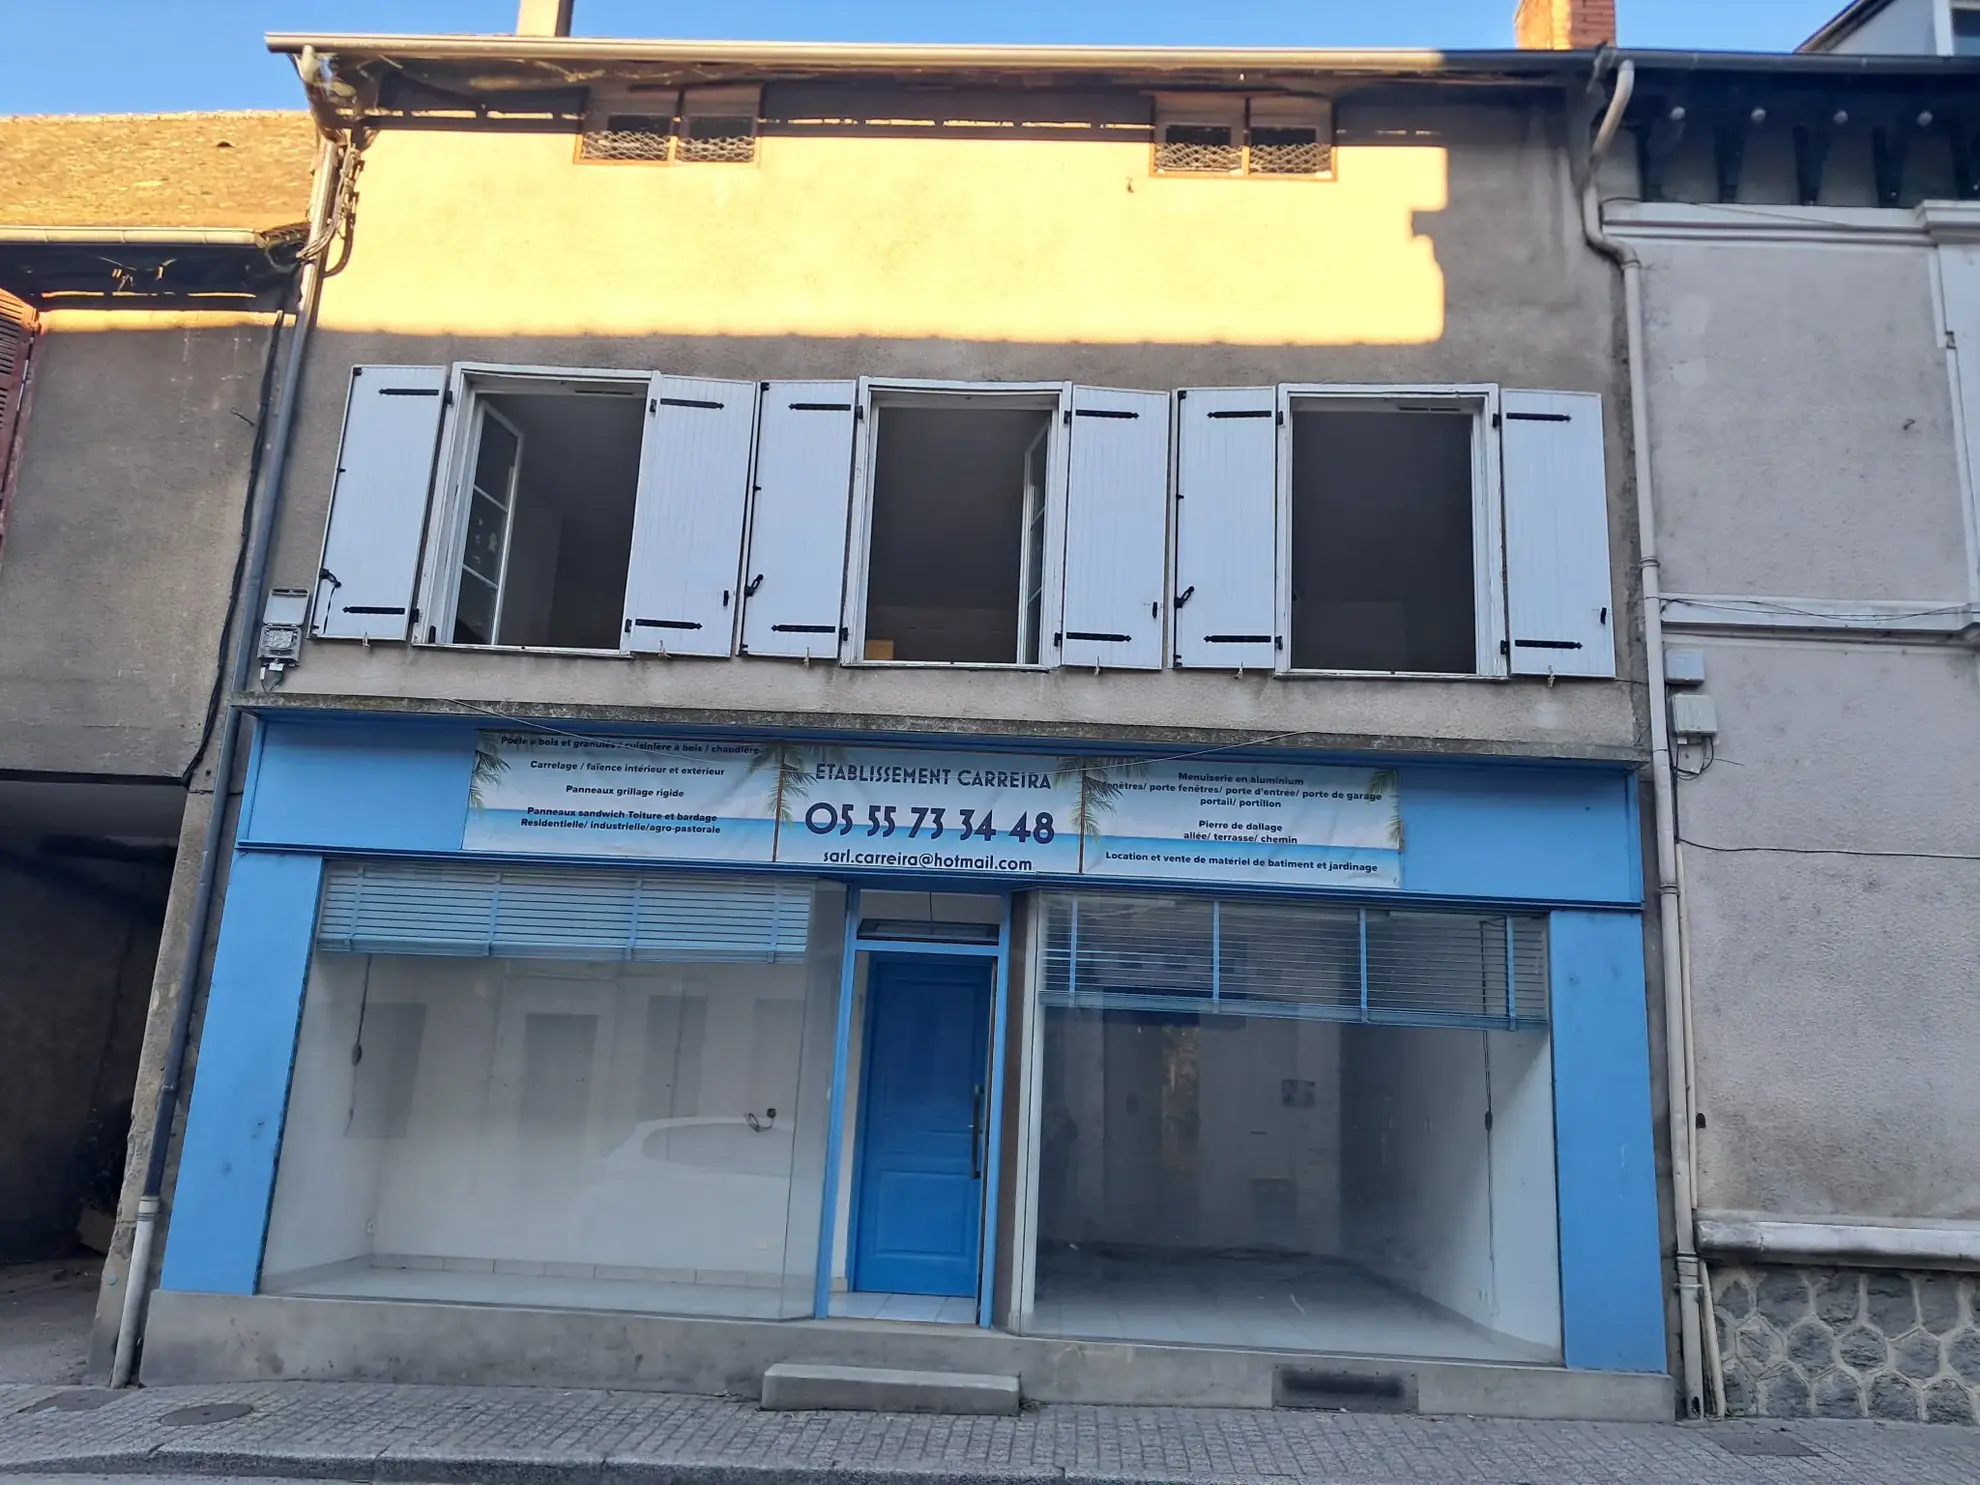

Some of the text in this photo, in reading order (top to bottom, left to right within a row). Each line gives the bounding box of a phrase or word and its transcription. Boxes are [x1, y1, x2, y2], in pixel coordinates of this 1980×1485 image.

[538, 737, 559, 746] bois
[682, 744, 703, 753] bois
[530, 760, 578, 772] Carrelage
[586, 763, 622, 773] faïence
[624, 764, 667, 774] intérieur
[669, 766, 679, 774] et
[681, 766, 725, 776] extérieur
[815, 763, 1052, 790] ETABLISSEMENT CARREIRA
[1178, 772, 1233, 783] Menuiserie
[1250, 776, 1304, 786] aluminium
[566, 785, 685, 798] Panneaux grillage rigide
[1150, 784, 1176, 792] porte
[1178, 784, 1224, 794] fenêtres/
[1225, 788, 1252, 796] porte
[1302, 790, 1329, 799] porte
[1331, 790, 1345, 800] de
[1347, 792, 1382, 802] garage
[1239, 799, 1282, 808] portillon
[527, 806, 718, 824] Panneaux sandwich Toiture et bardage
[805, 802, 1055, 844] 05 55 73 34 48
[521, 818, 588, 829] Residentielle/
[1198, 820, 1283, 833] Pierre de dallage
[1214, 833, 1258, 842] terrasse/
[1260, 835, 1298, 844] chemin
[823, 848, 1032, 870] sarl.carreira@hotmail.com
[1106, 851, 1378, 874] Location et vente de matériel de batiment et jardinage
